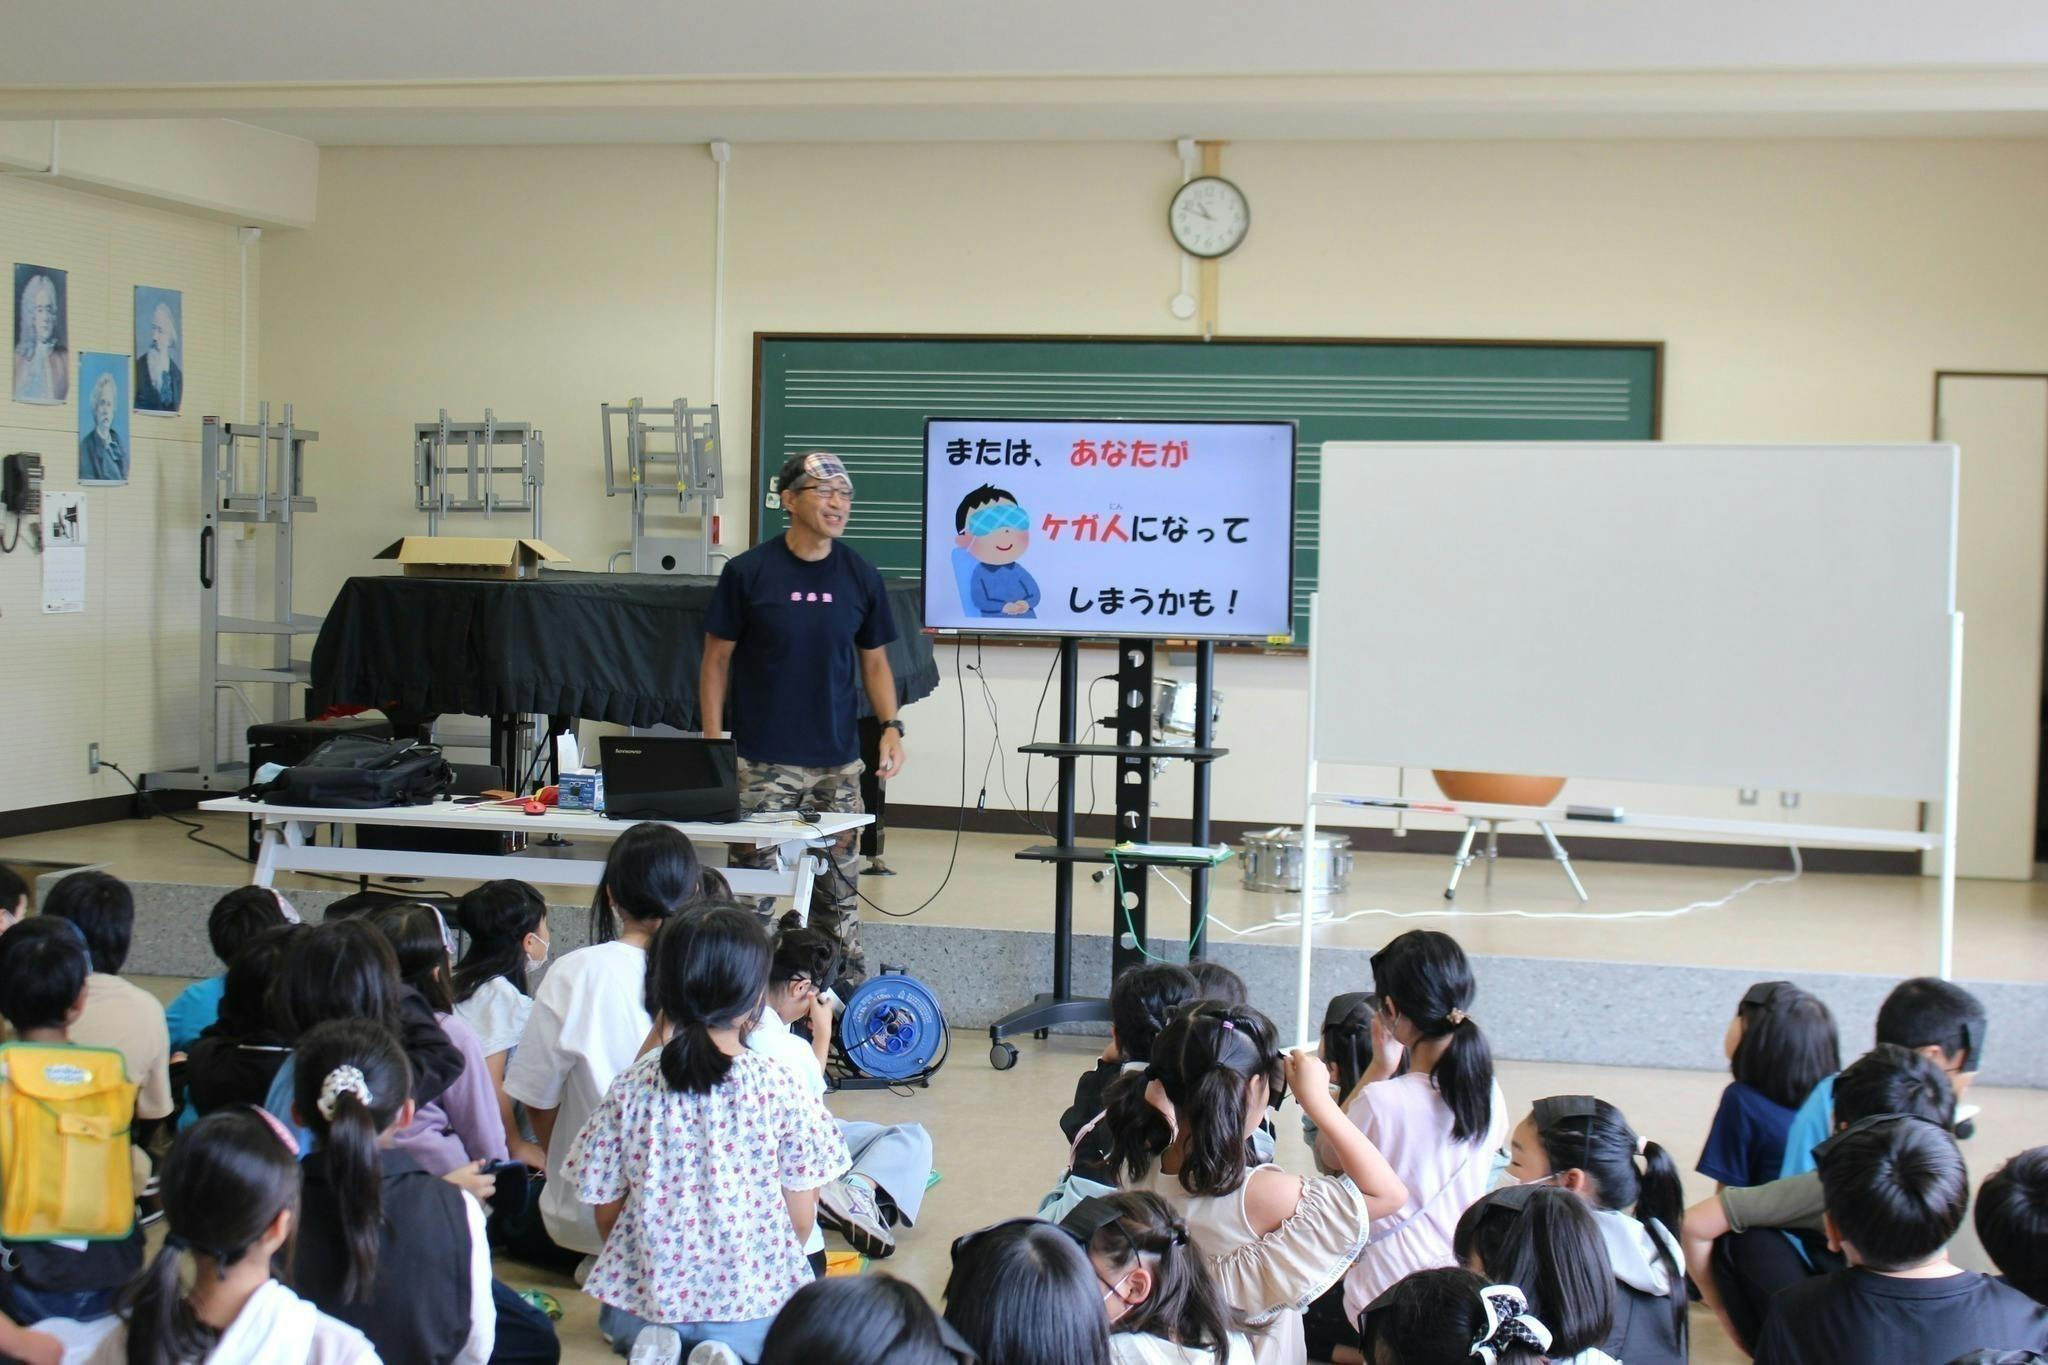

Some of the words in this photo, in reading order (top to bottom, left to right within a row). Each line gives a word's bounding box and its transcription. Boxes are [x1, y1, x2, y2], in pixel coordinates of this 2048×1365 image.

[946, 437, 1044, 467] または、
[1070, 439, 1189, 468] あなたが
[1041, 513, 1250, 544] ケガ人になって
[1069, 586, 1239, 618] しまうかも！
